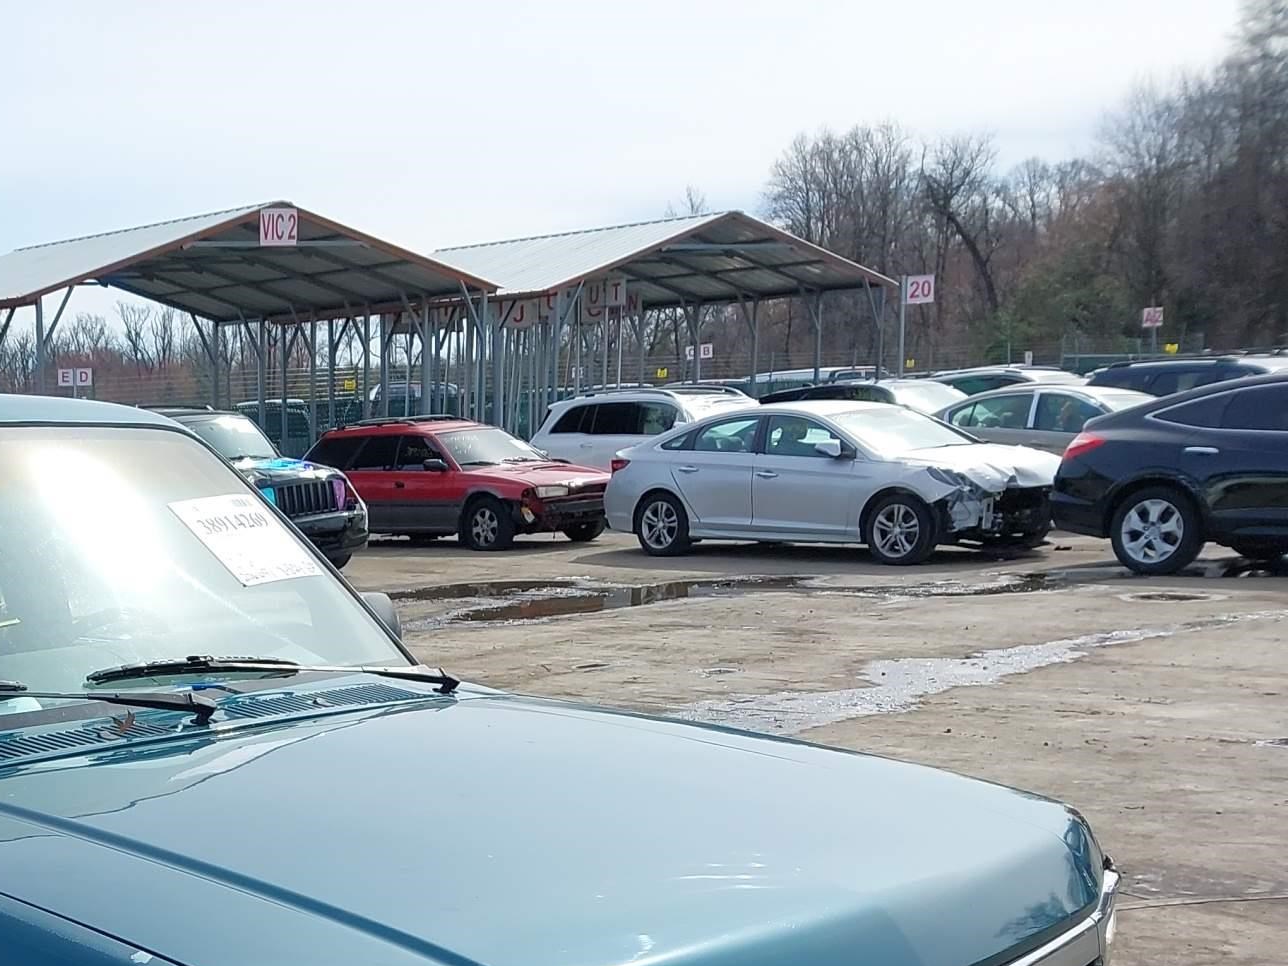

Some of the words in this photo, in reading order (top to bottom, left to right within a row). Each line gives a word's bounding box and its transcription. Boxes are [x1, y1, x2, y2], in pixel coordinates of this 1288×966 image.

[262, 213, 285, 240] VIC
[288, 213, 296, 240] 2
[909, 280, 932, 299] 20
[62, 371, 70, 383] E
[79, 371, 89, 383] D
[196, 512, 269, 535] 38914269
